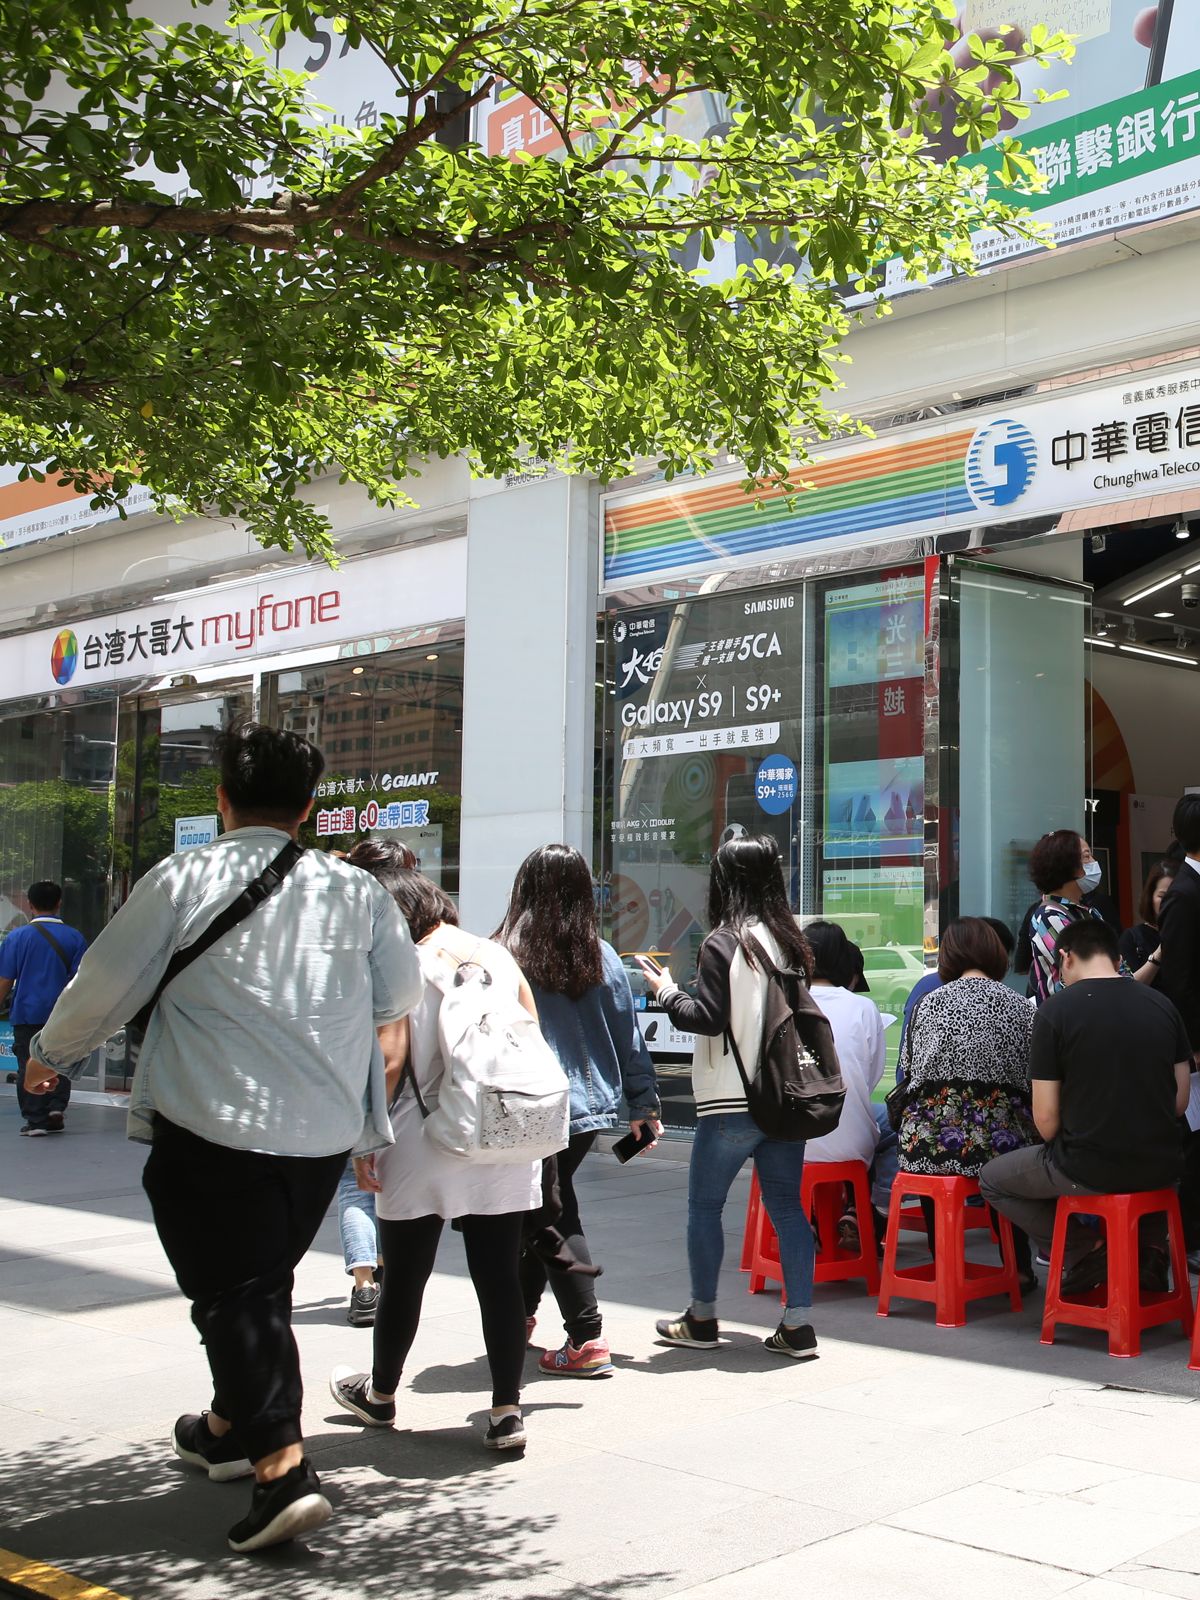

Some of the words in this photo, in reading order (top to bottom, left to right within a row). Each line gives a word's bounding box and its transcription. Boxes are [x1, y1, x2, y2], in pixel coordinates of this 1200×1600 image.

[1093, 467, 1158, 490] Chunghwa
[744, 596, 795, 615] SAMSUNG
[83, 614, 195, 670] 台湾大哥大
[201, 588, 341, 650] myfone
[629, 618, 656, 631] 中華電信
[708, 638, 743, 652] 王者聯手
[737, 631, 782, 661] 5CA
[701, 653, 735, 667] 唯一支援
[622, 698, 694, 728] Galaxy
[698, 690, 723, 718] S9
[746, 684, 782, 712] S9+
[627, 738, 675, 755] 最大頻寬
[758, 767, 794, 782] 中華獨家
[317, 777, 366, 797] 台湾大哥大
[393, 771, 439, 789] GIANT
[758, 784, 777, 799] S9+
[317, 807, 356, 835] 自由選
[359, 801, 430, 831] $0起帶回家
[626, 820, 640, 828] AKG
[657, 818, 676, 827] DOLBY
[610, 830, 676, 843] 享受極致影音饗宴
